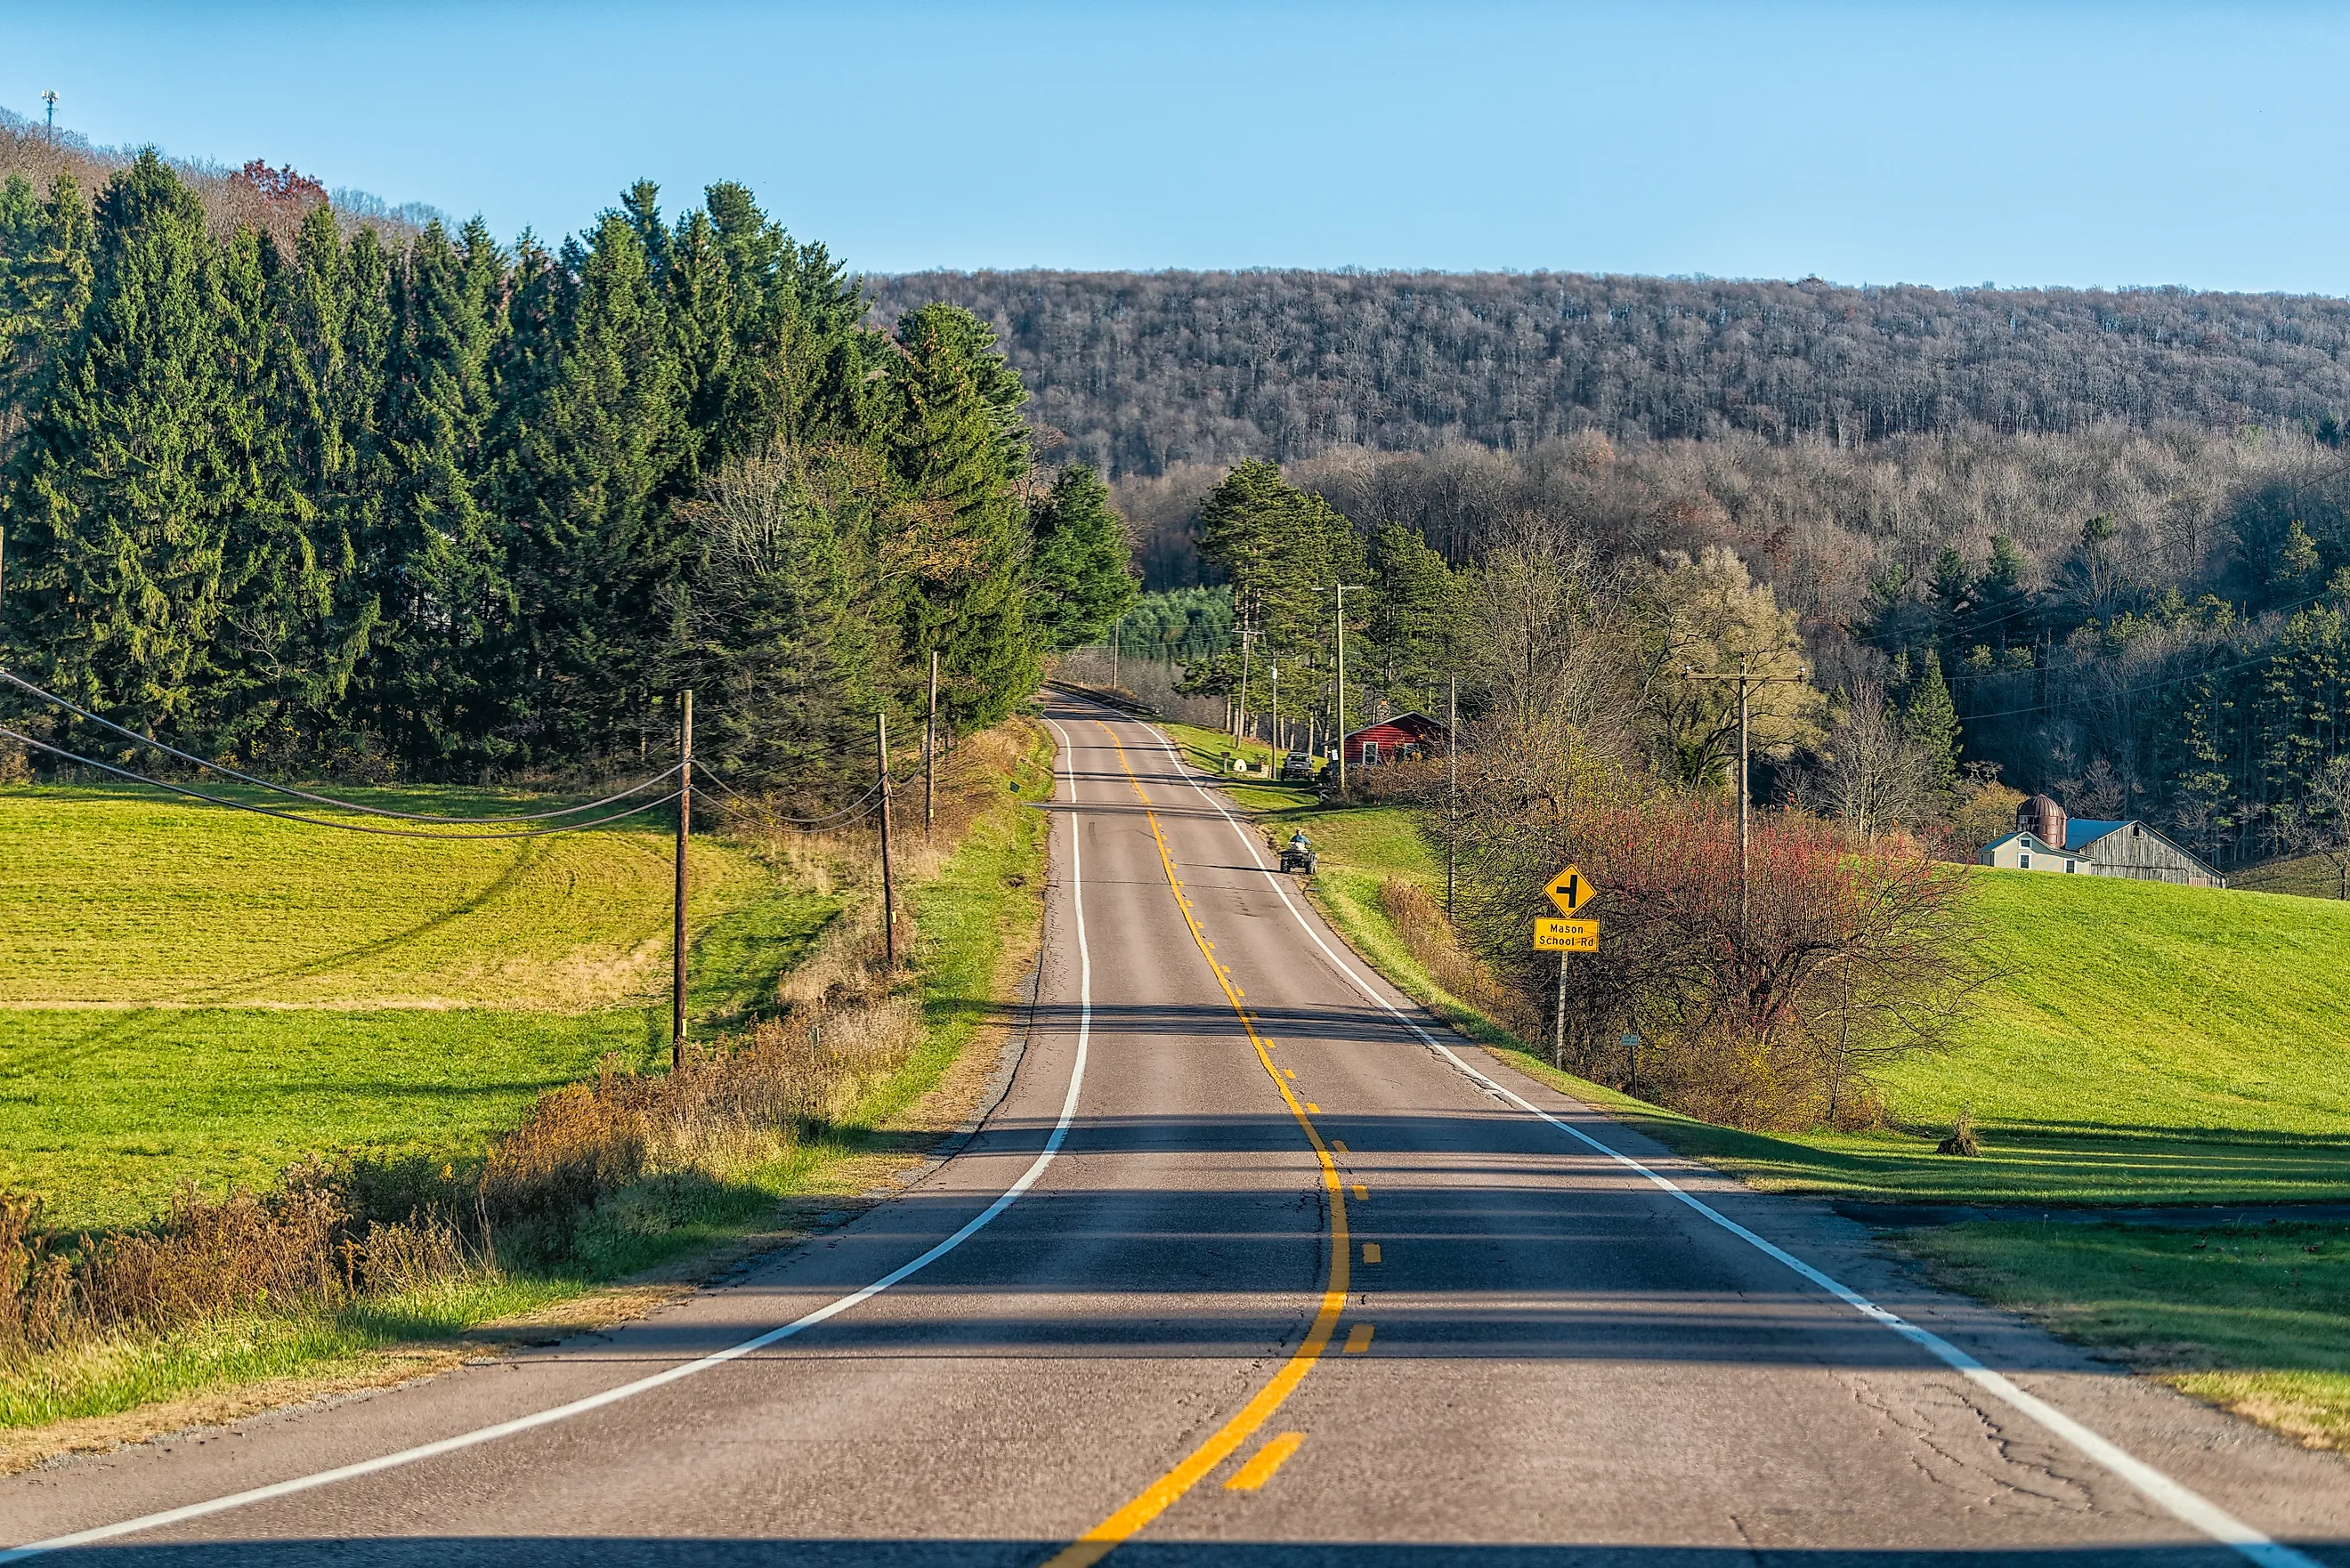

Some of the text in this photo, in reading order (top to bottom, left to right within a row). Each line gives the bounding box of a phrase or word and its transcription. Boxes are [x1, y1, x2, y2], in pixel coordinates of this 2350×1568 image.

[1550, 924, 1584, 934] Mason
[1539, 935, 1593, 947] School Rd
